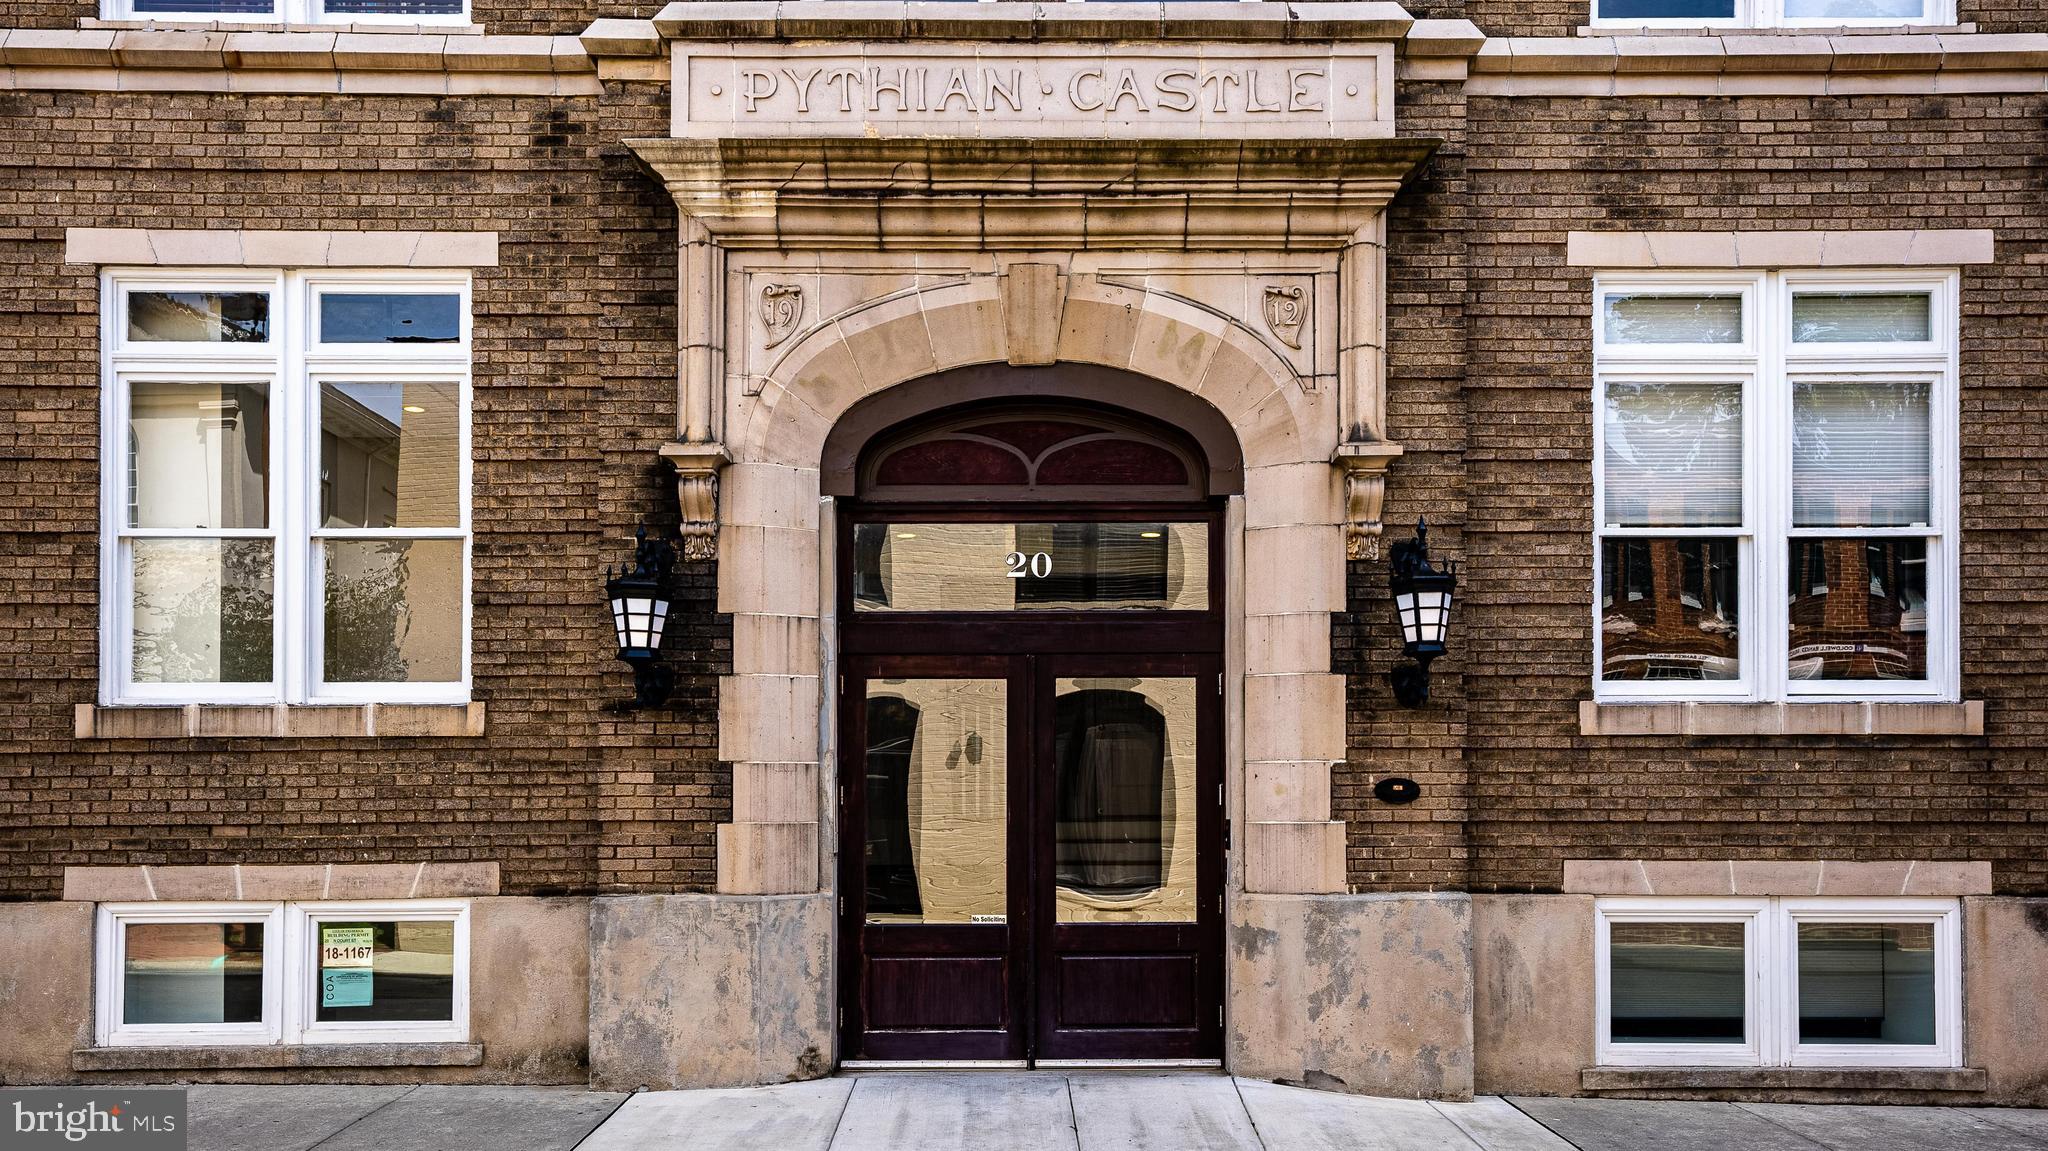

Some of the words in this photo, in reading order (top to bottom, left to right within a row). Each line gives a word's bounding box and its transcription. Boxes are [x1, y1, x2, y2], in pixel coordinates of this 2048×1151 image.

[743, 67, 1022, 113] PYTHIAN
[1069, 68, 1325, 113] CASTLE
[767, 300, 793, 327] 19
[1273, 300, 1299, 327] 12
[1004, 551, 1053, 578] 20
[325, 947, 371, 959] 18-1167
[326, 975, 334, 1000] COA
